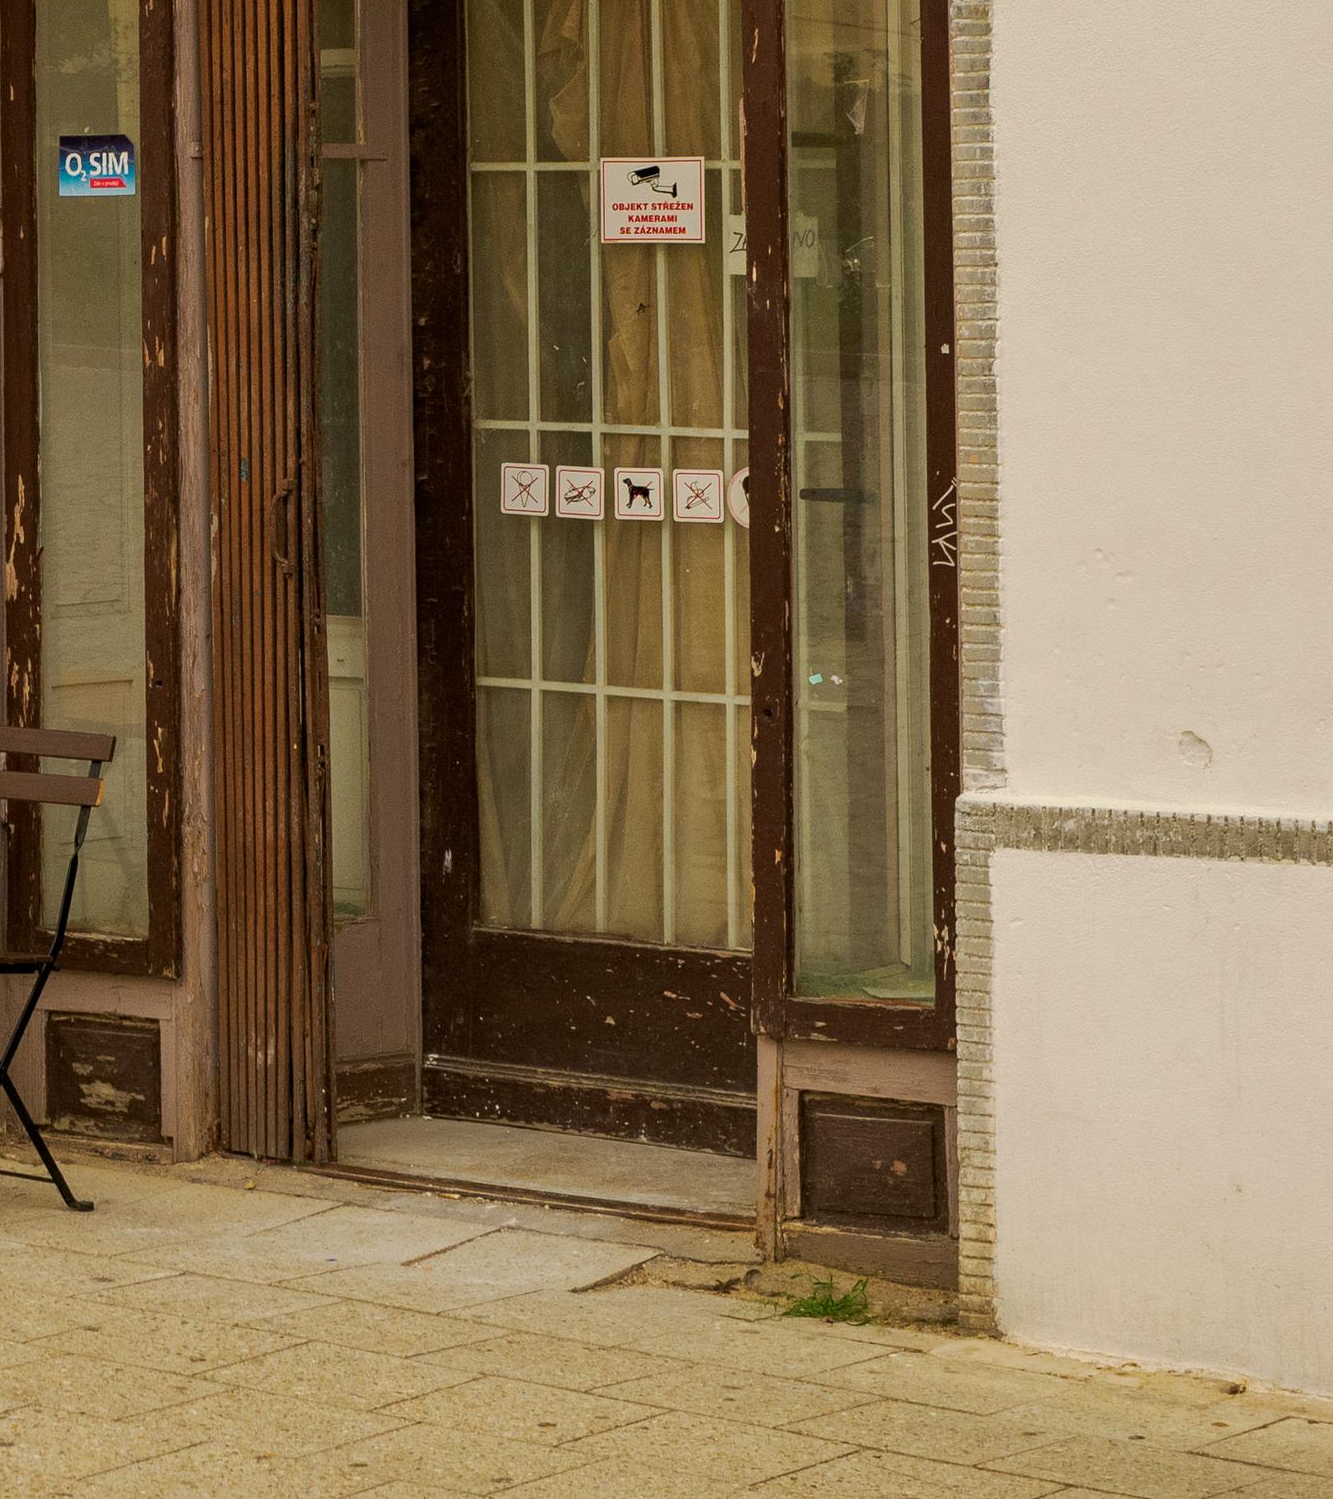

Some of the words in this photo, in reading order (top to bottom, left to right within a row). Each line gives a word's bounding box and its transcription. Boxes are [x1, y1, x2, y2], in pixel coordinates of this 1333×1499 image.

[89, 150, 129, 176] SIM
[612, 202, 649, 211] OBJEKT
[651, 200, 694, 211] STŘEŽEN
[628, 214, 678, 223] KAMERAMI
[619, 226, 632, 235] SE
[634, 224, 686, 235] ZÁZNAMEM
